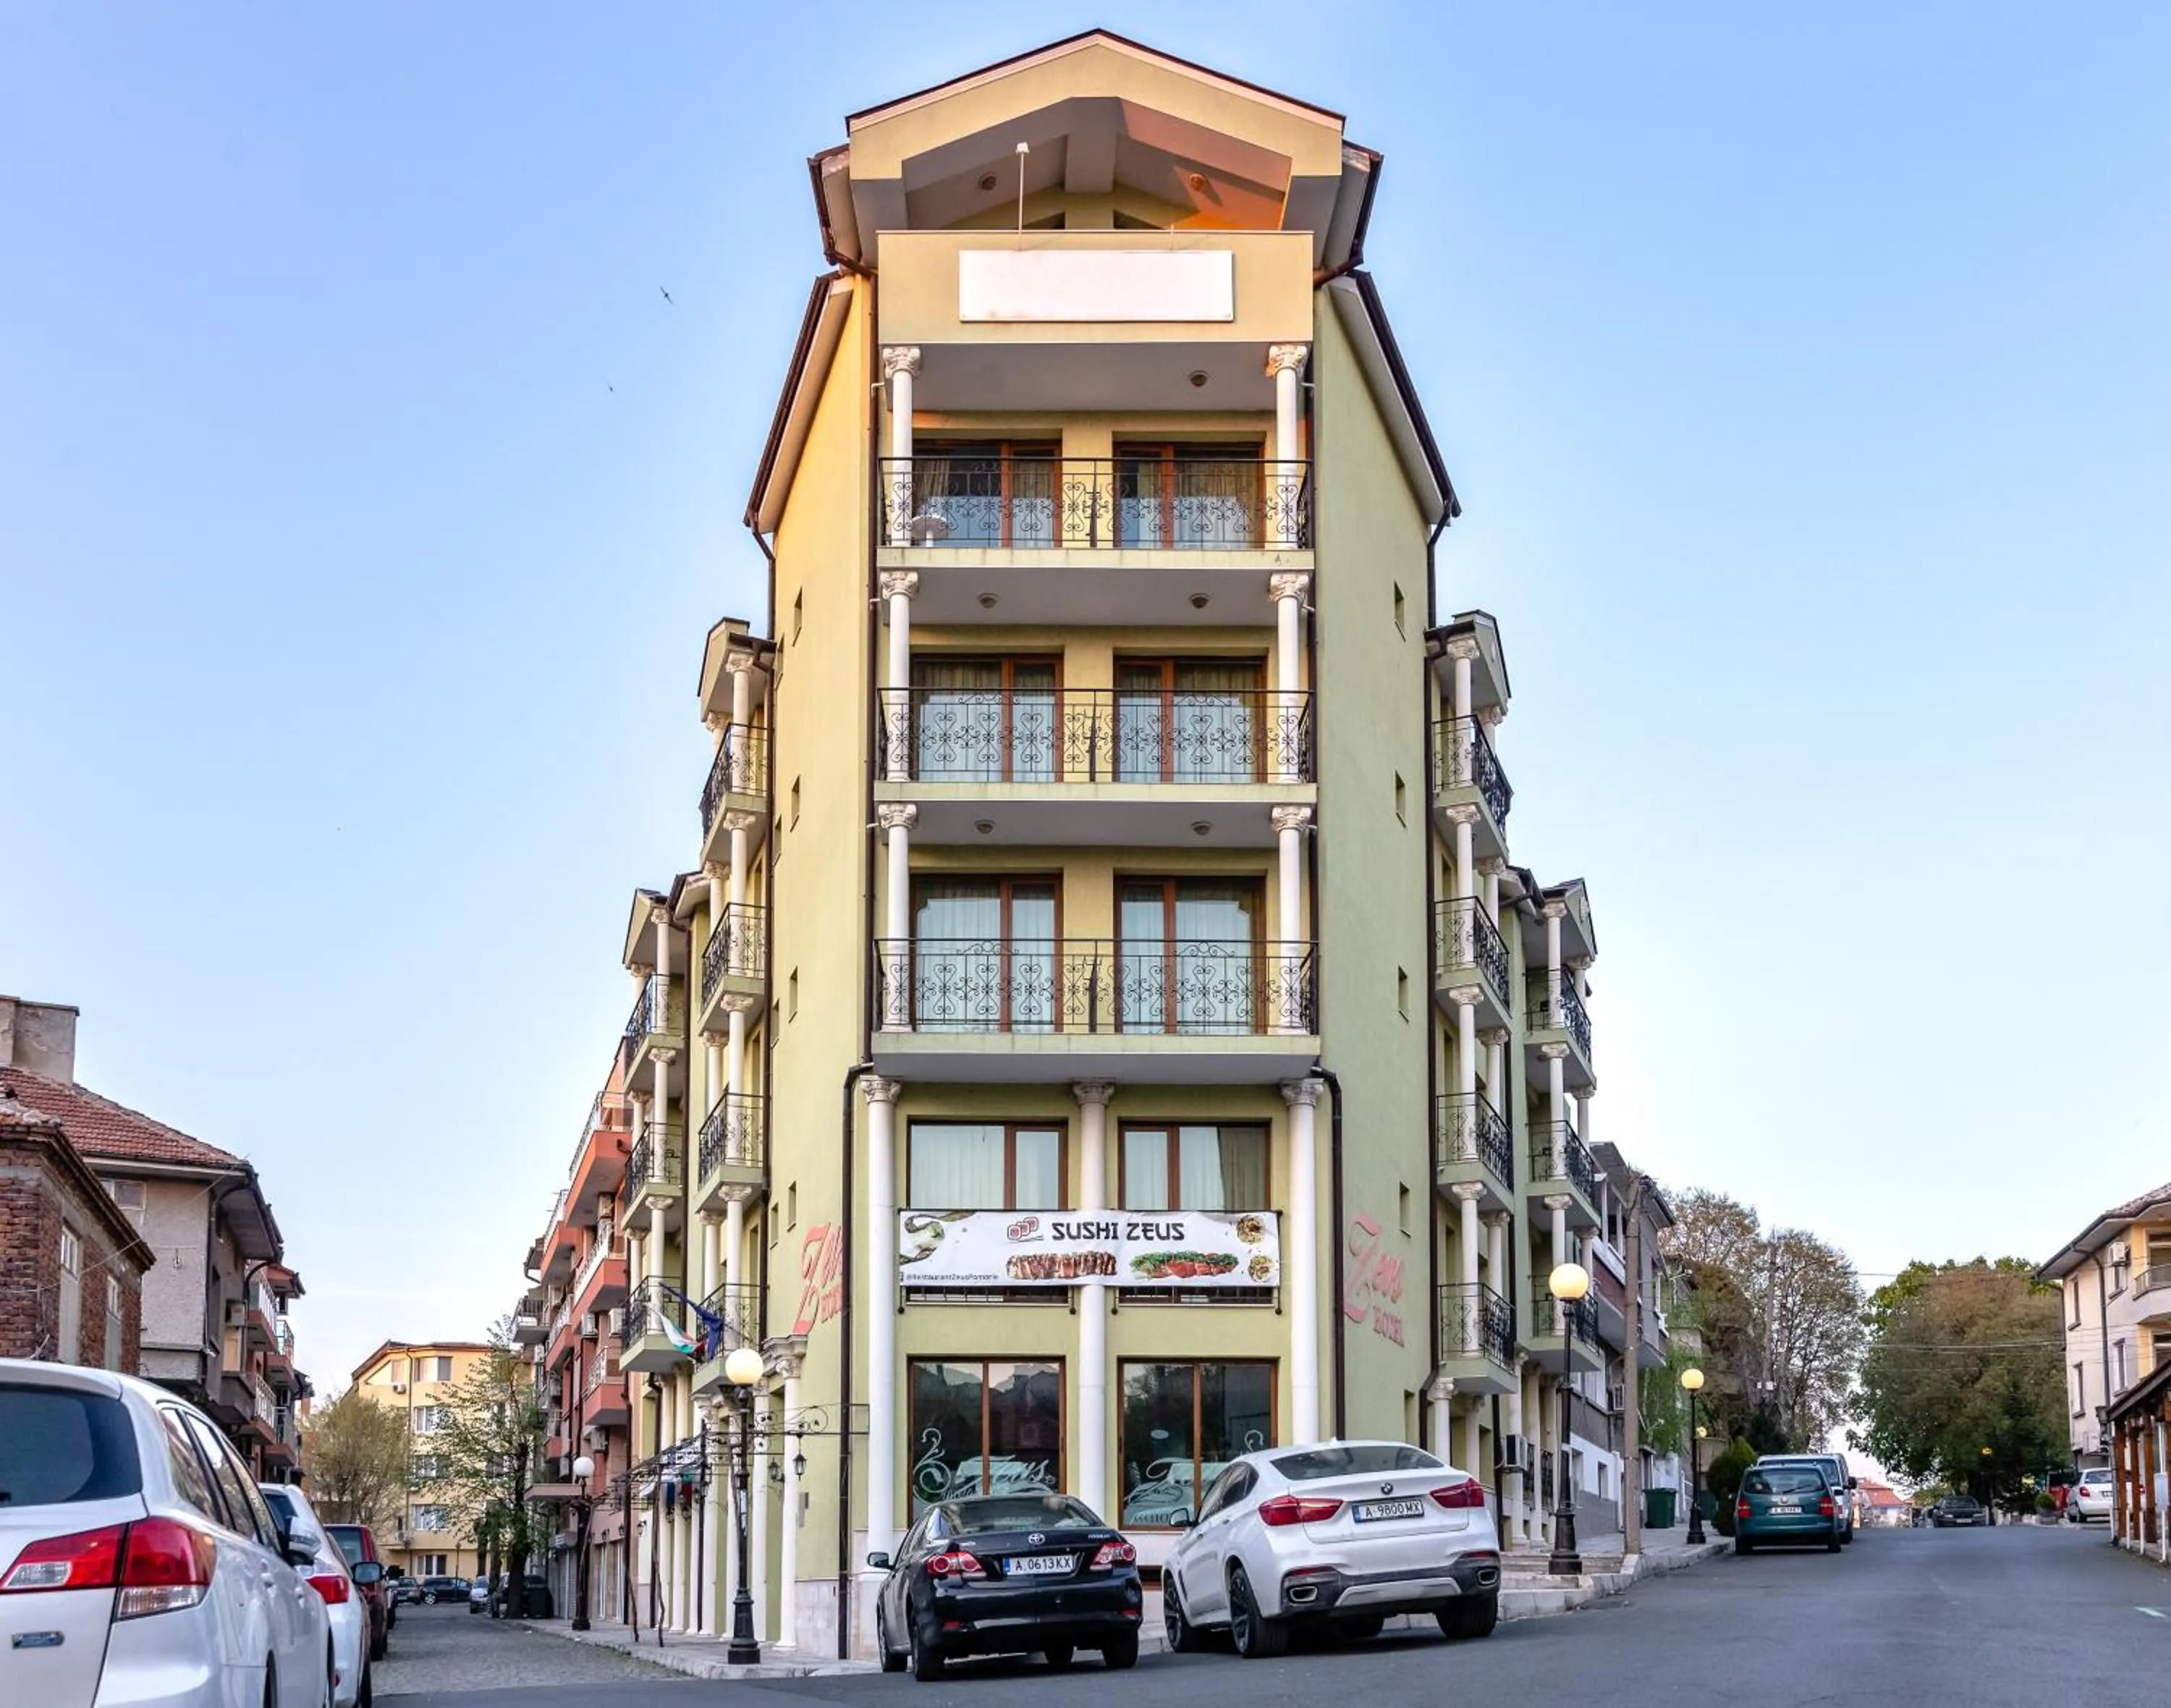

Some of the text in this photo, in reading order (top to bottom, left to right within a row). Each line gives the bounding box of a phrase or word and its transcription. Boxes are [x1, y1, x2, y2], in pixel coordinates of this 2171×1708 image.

[1051, 1222, 1184, 1240] SUSHI ZEUS
[1366, 1507, 1373, 1517] A
[1015, 1560, 1023, 1571] A
